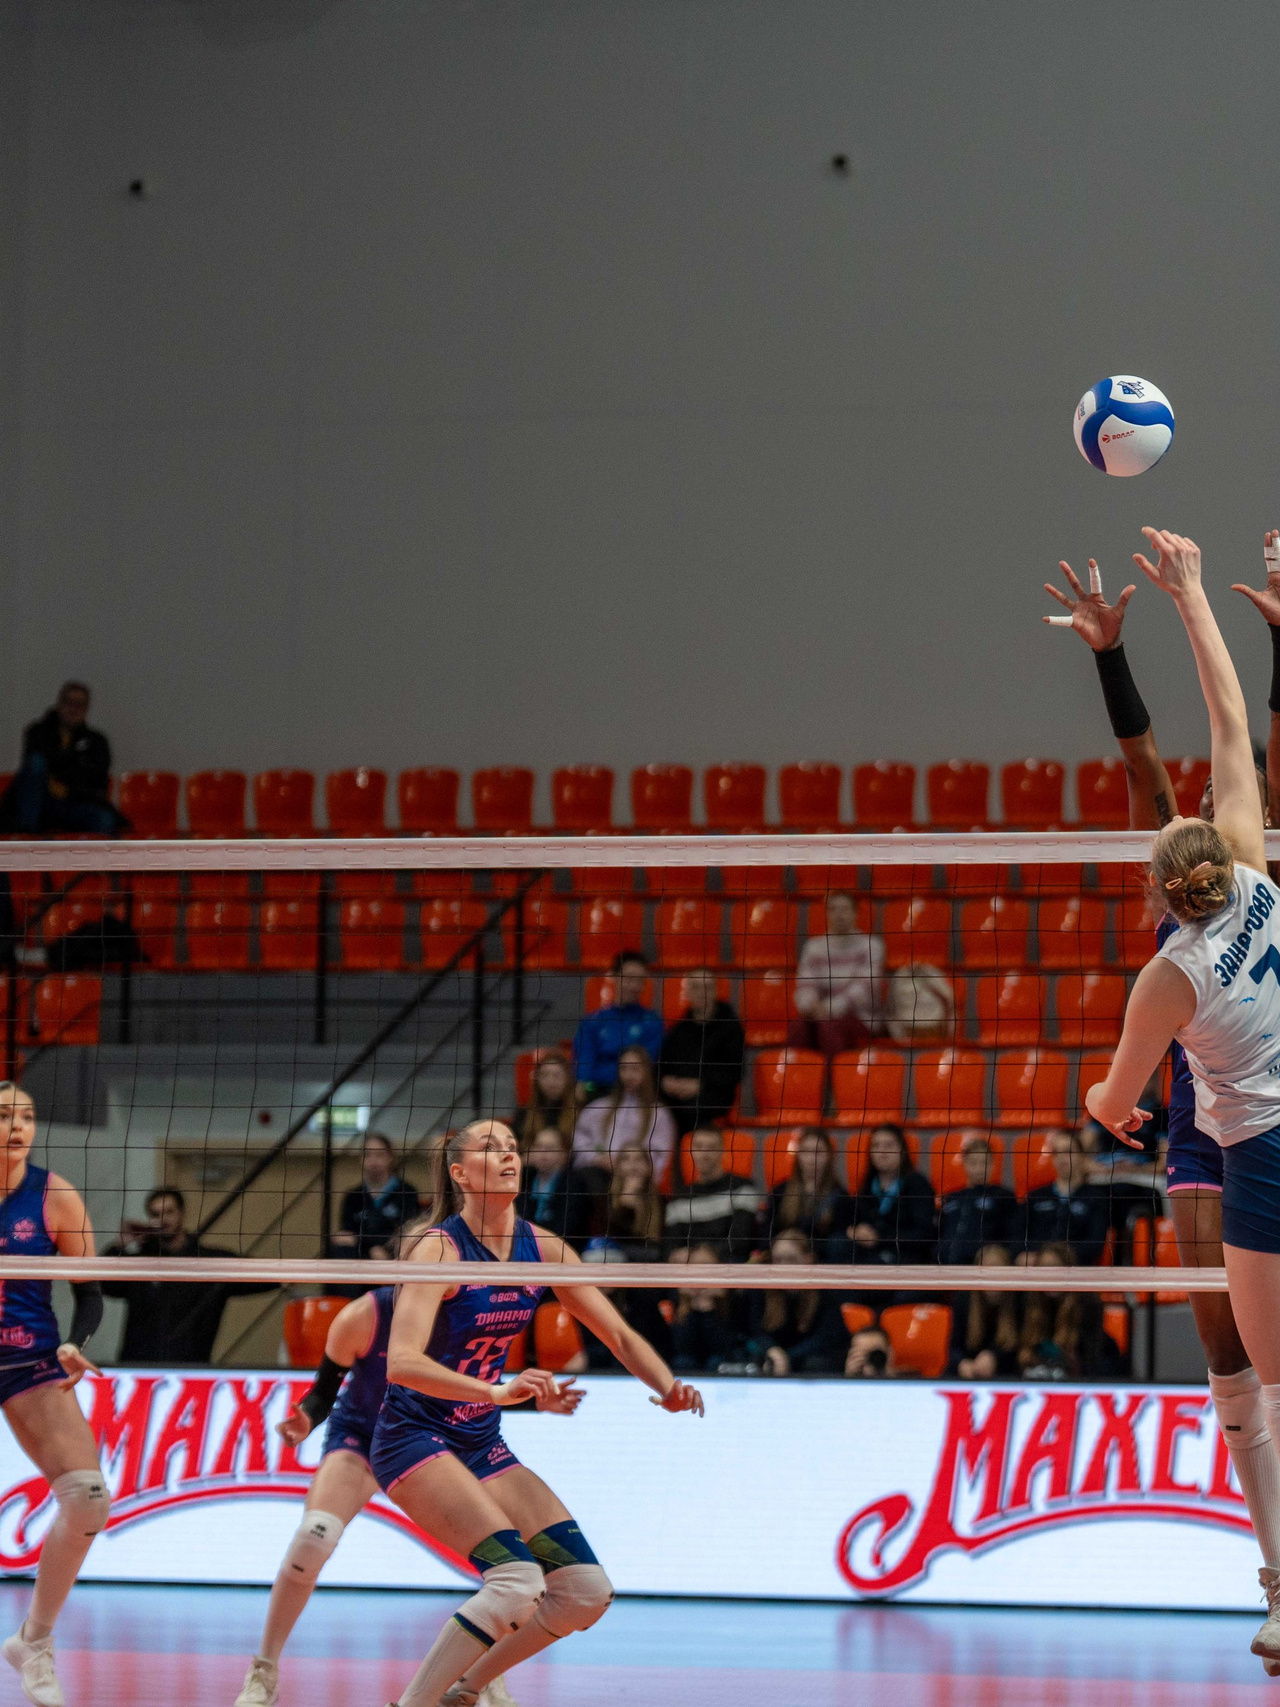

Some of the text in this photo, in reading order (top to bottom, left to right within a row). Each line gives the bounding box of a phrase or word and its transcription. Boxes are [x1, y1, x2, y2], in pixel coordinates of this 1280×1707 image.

[498, 1292, 519, 1303] ВФВ
[475, 1309, 531, 1326] ДИНАМО
[456, 1334, 519, 1384] 22
